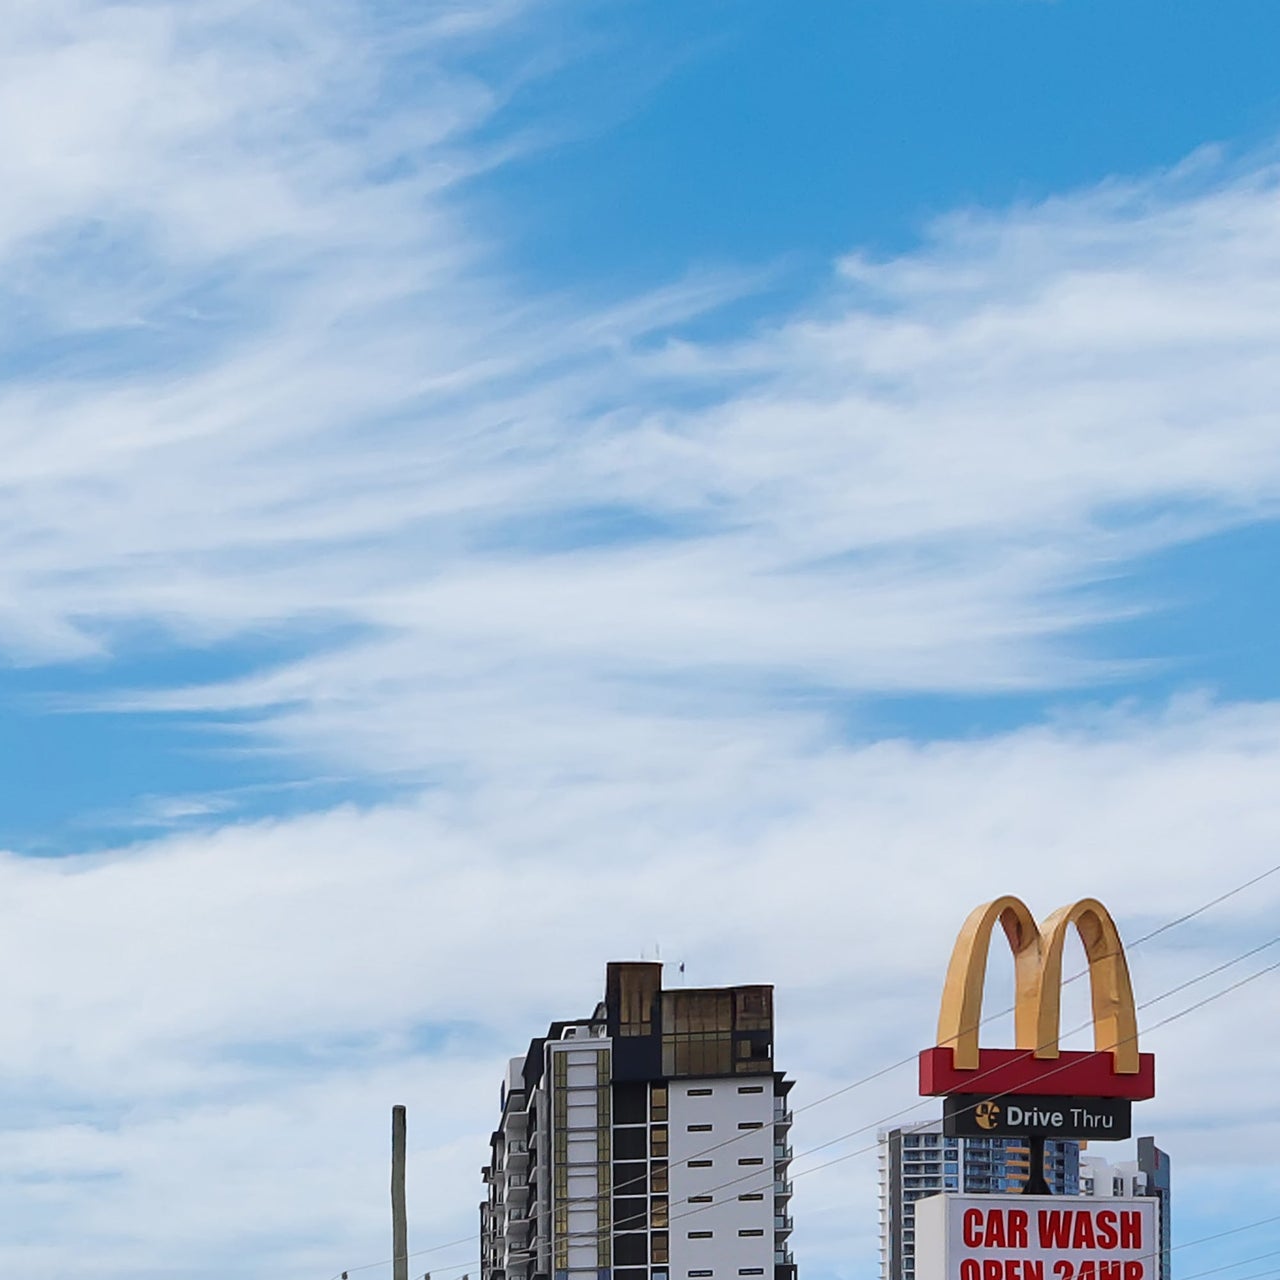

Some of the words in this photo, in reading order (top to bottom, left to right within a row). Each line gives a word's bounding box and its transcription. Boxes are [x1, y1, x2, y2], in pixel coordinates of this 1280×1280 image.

[1006, 1104, 1064, 1128] Drive
[1070, 1108, 1114, 1129] Thru
[962, 1207, 1029, 1250] CAR
[1037, 1209, 1142, 1250] WASH
